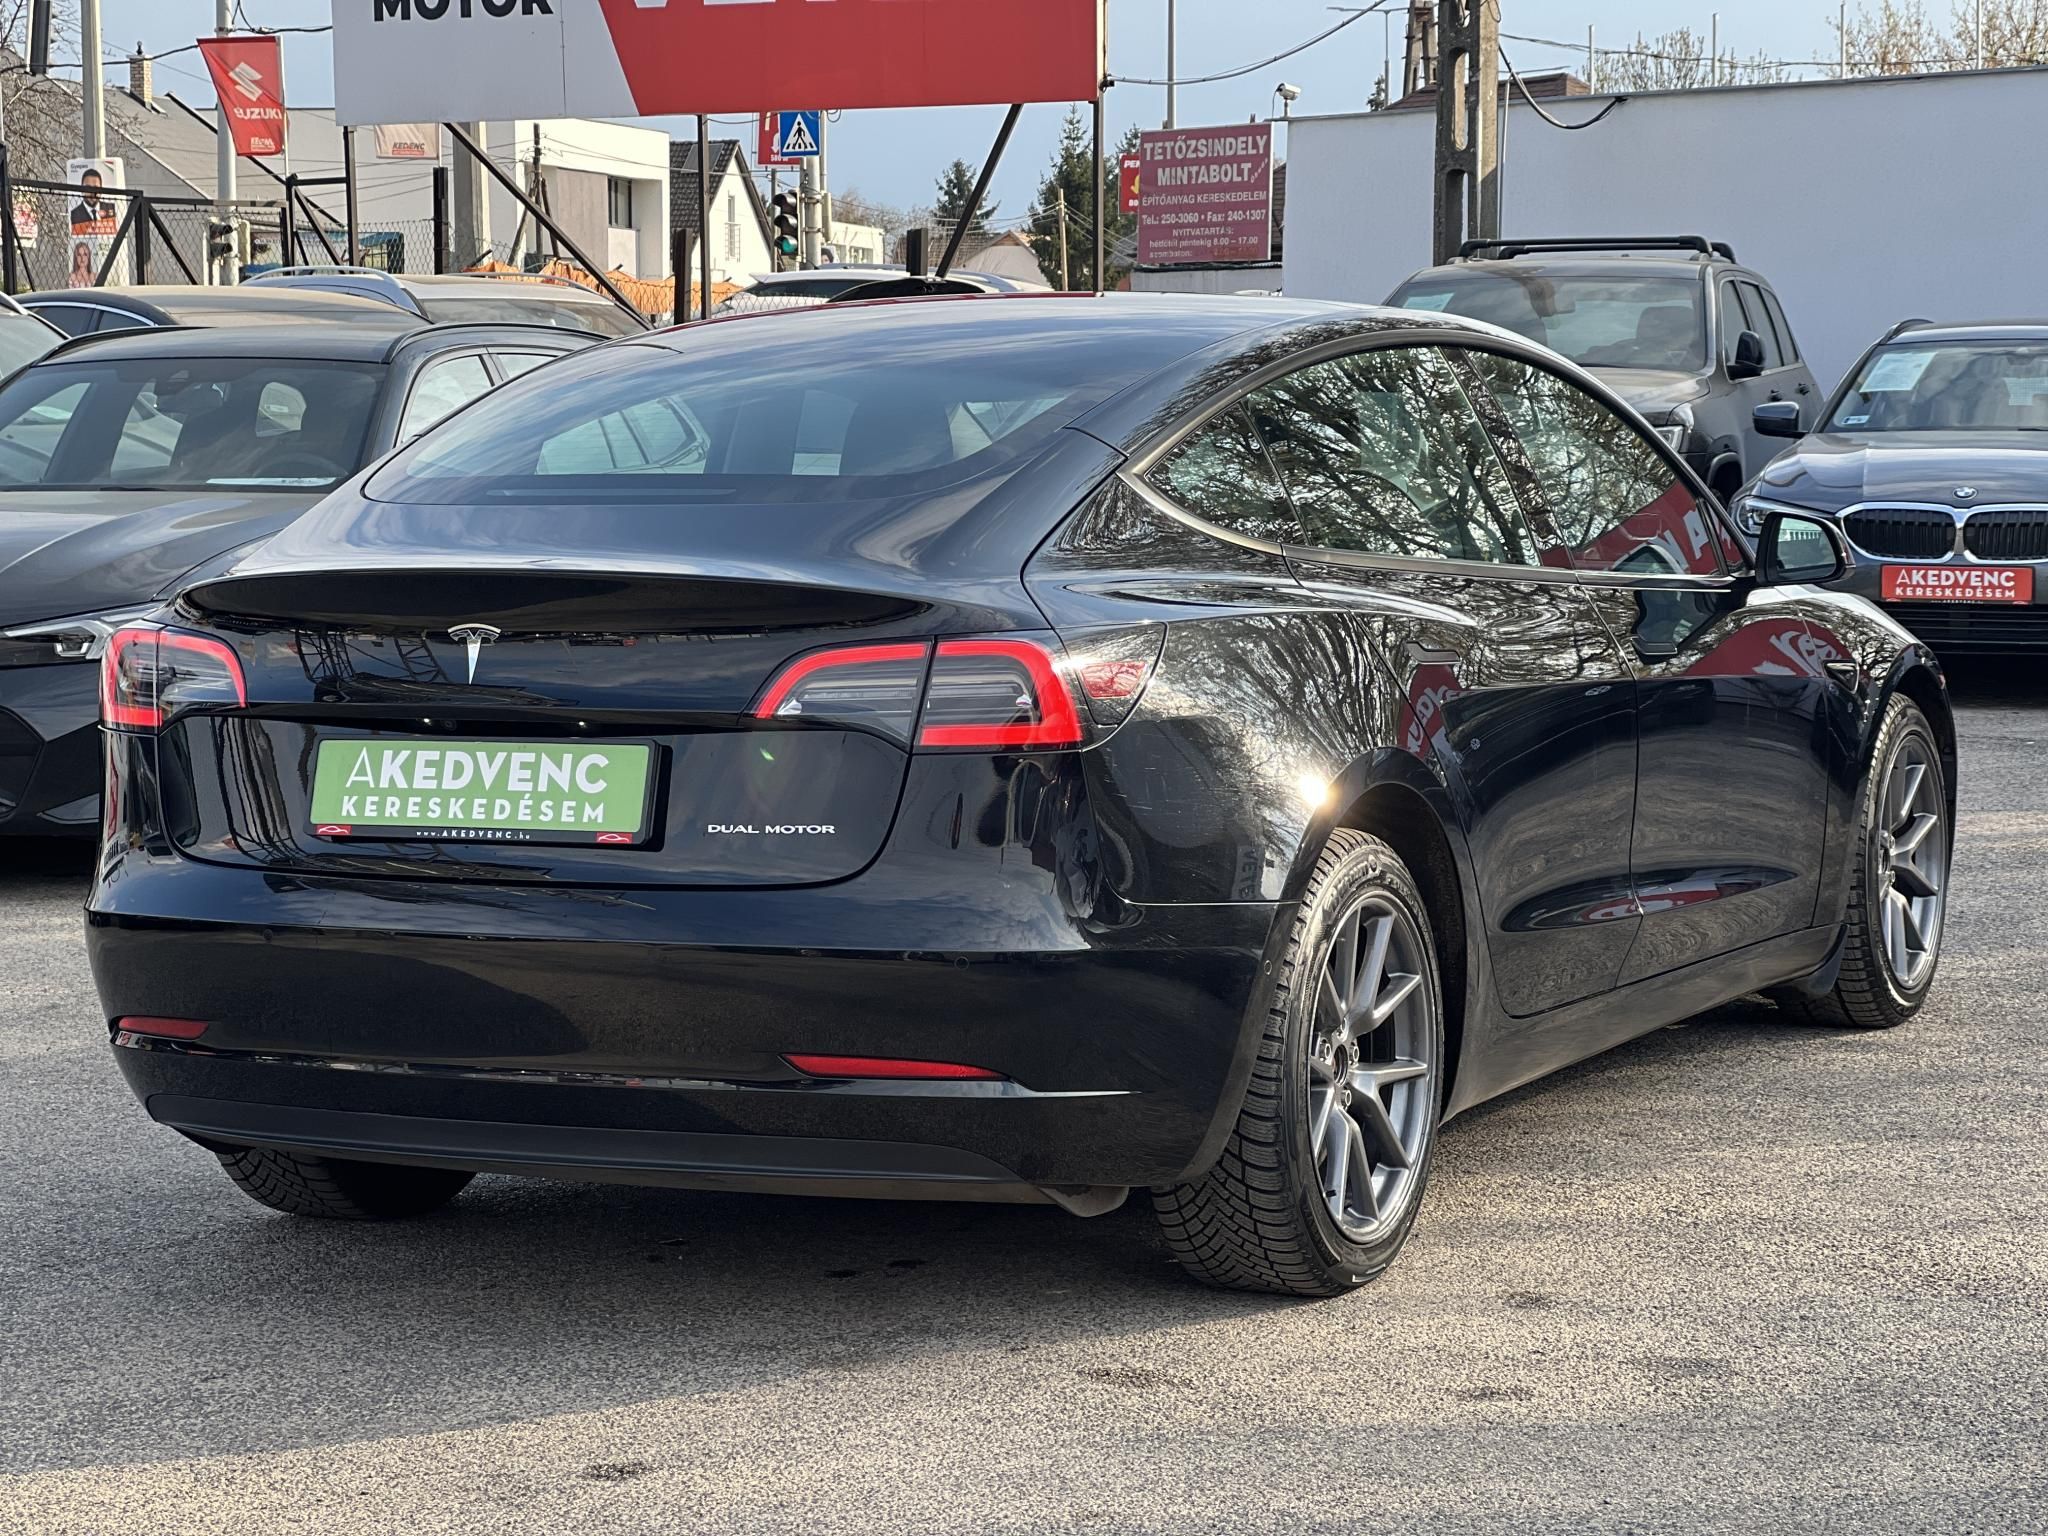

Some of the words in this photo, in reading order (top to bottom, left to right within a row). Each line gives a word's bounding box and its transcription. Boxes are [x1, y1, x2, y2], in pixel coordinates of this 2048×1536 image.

[1143, 135, 1267, 161] TETŐZSINDELY
[1157, 162, 1251, 186] MINTABOLT
[1197, 191, 1267, 204] KERESKEDELEM
[1161, 213, 1199, 225] 250-3060
[1207, 211, 1225, 222] Fax:
[1227, 209, 1266, 221] 240-1307
[1896, 568, 2016, 587] AKEDVENC
[1895, 586, 2015, 598] KERESKEDÉSEM
[345, 746, 610, 794] AKEDVENC
[340, 792, 604, 824] KERESKEDÉSEM
[416, 829, 531, 841] www.AKEDVENC.hu
[707, 824, 760, 834] DUAL
[765, 824, 836, 834] MOTOR
